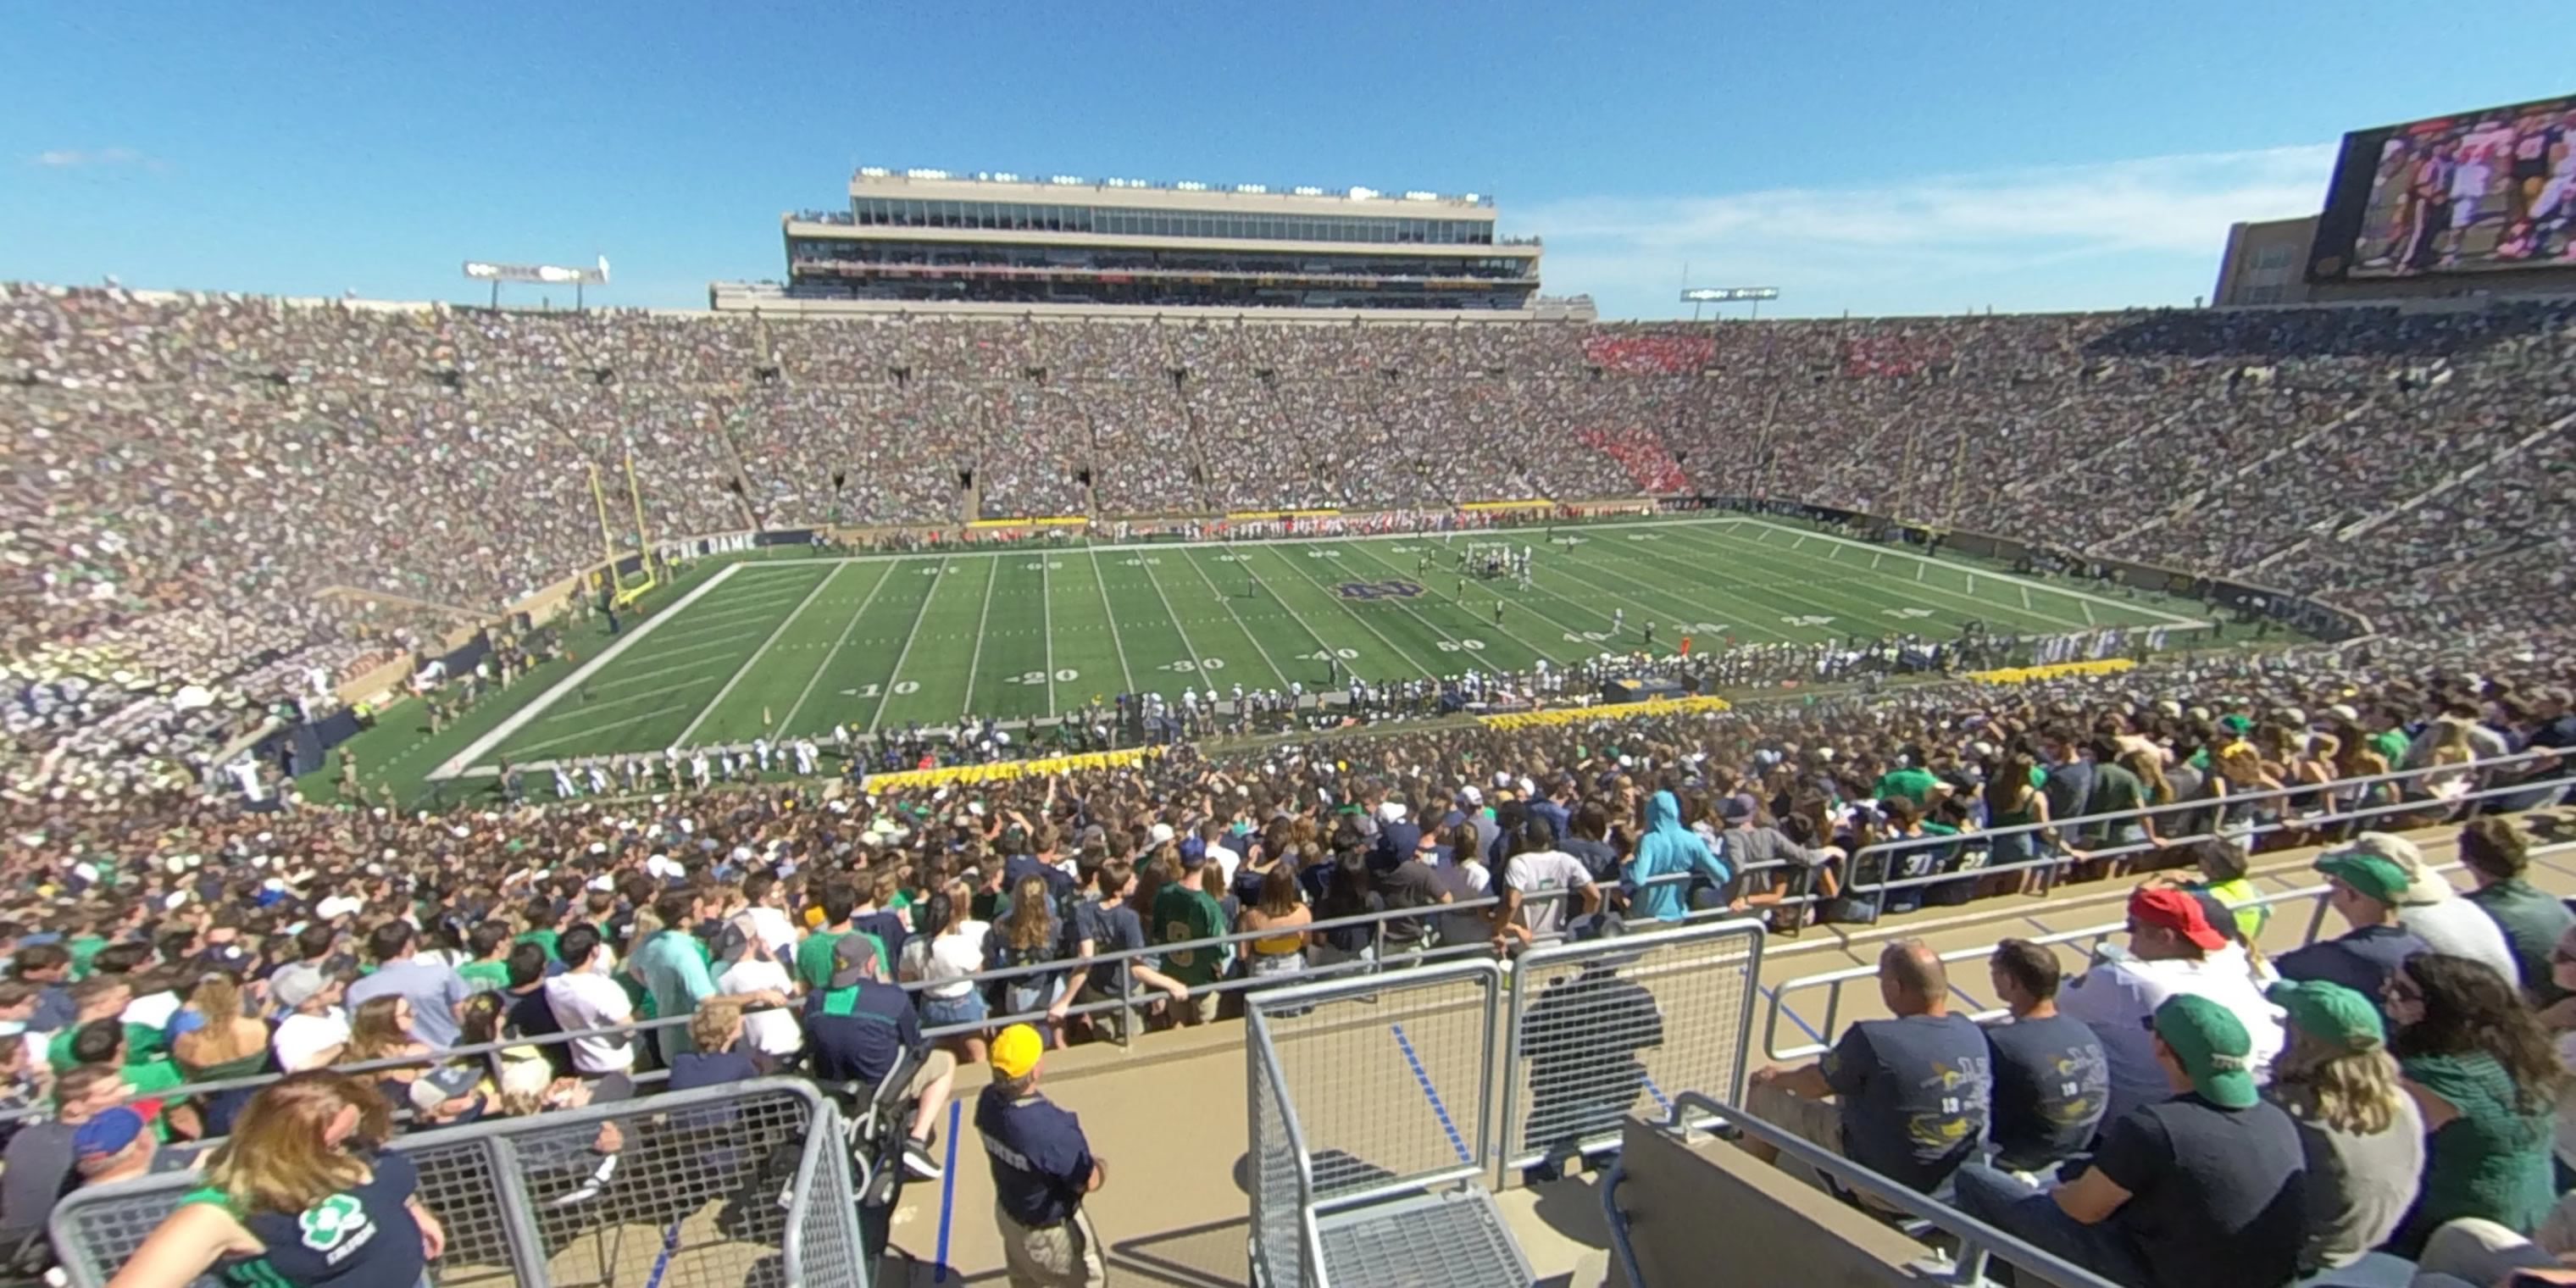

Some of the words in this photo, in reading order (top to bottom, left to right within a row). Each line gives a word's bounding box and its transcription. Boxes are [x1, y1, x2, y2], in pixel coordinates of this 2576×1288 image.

[1173, 658, 1225, 672] 30
[1023, 669, 1080, 686] 20
[858, 680, 920, 699] 10
[983, 1135, 1031, 1172] SHER
